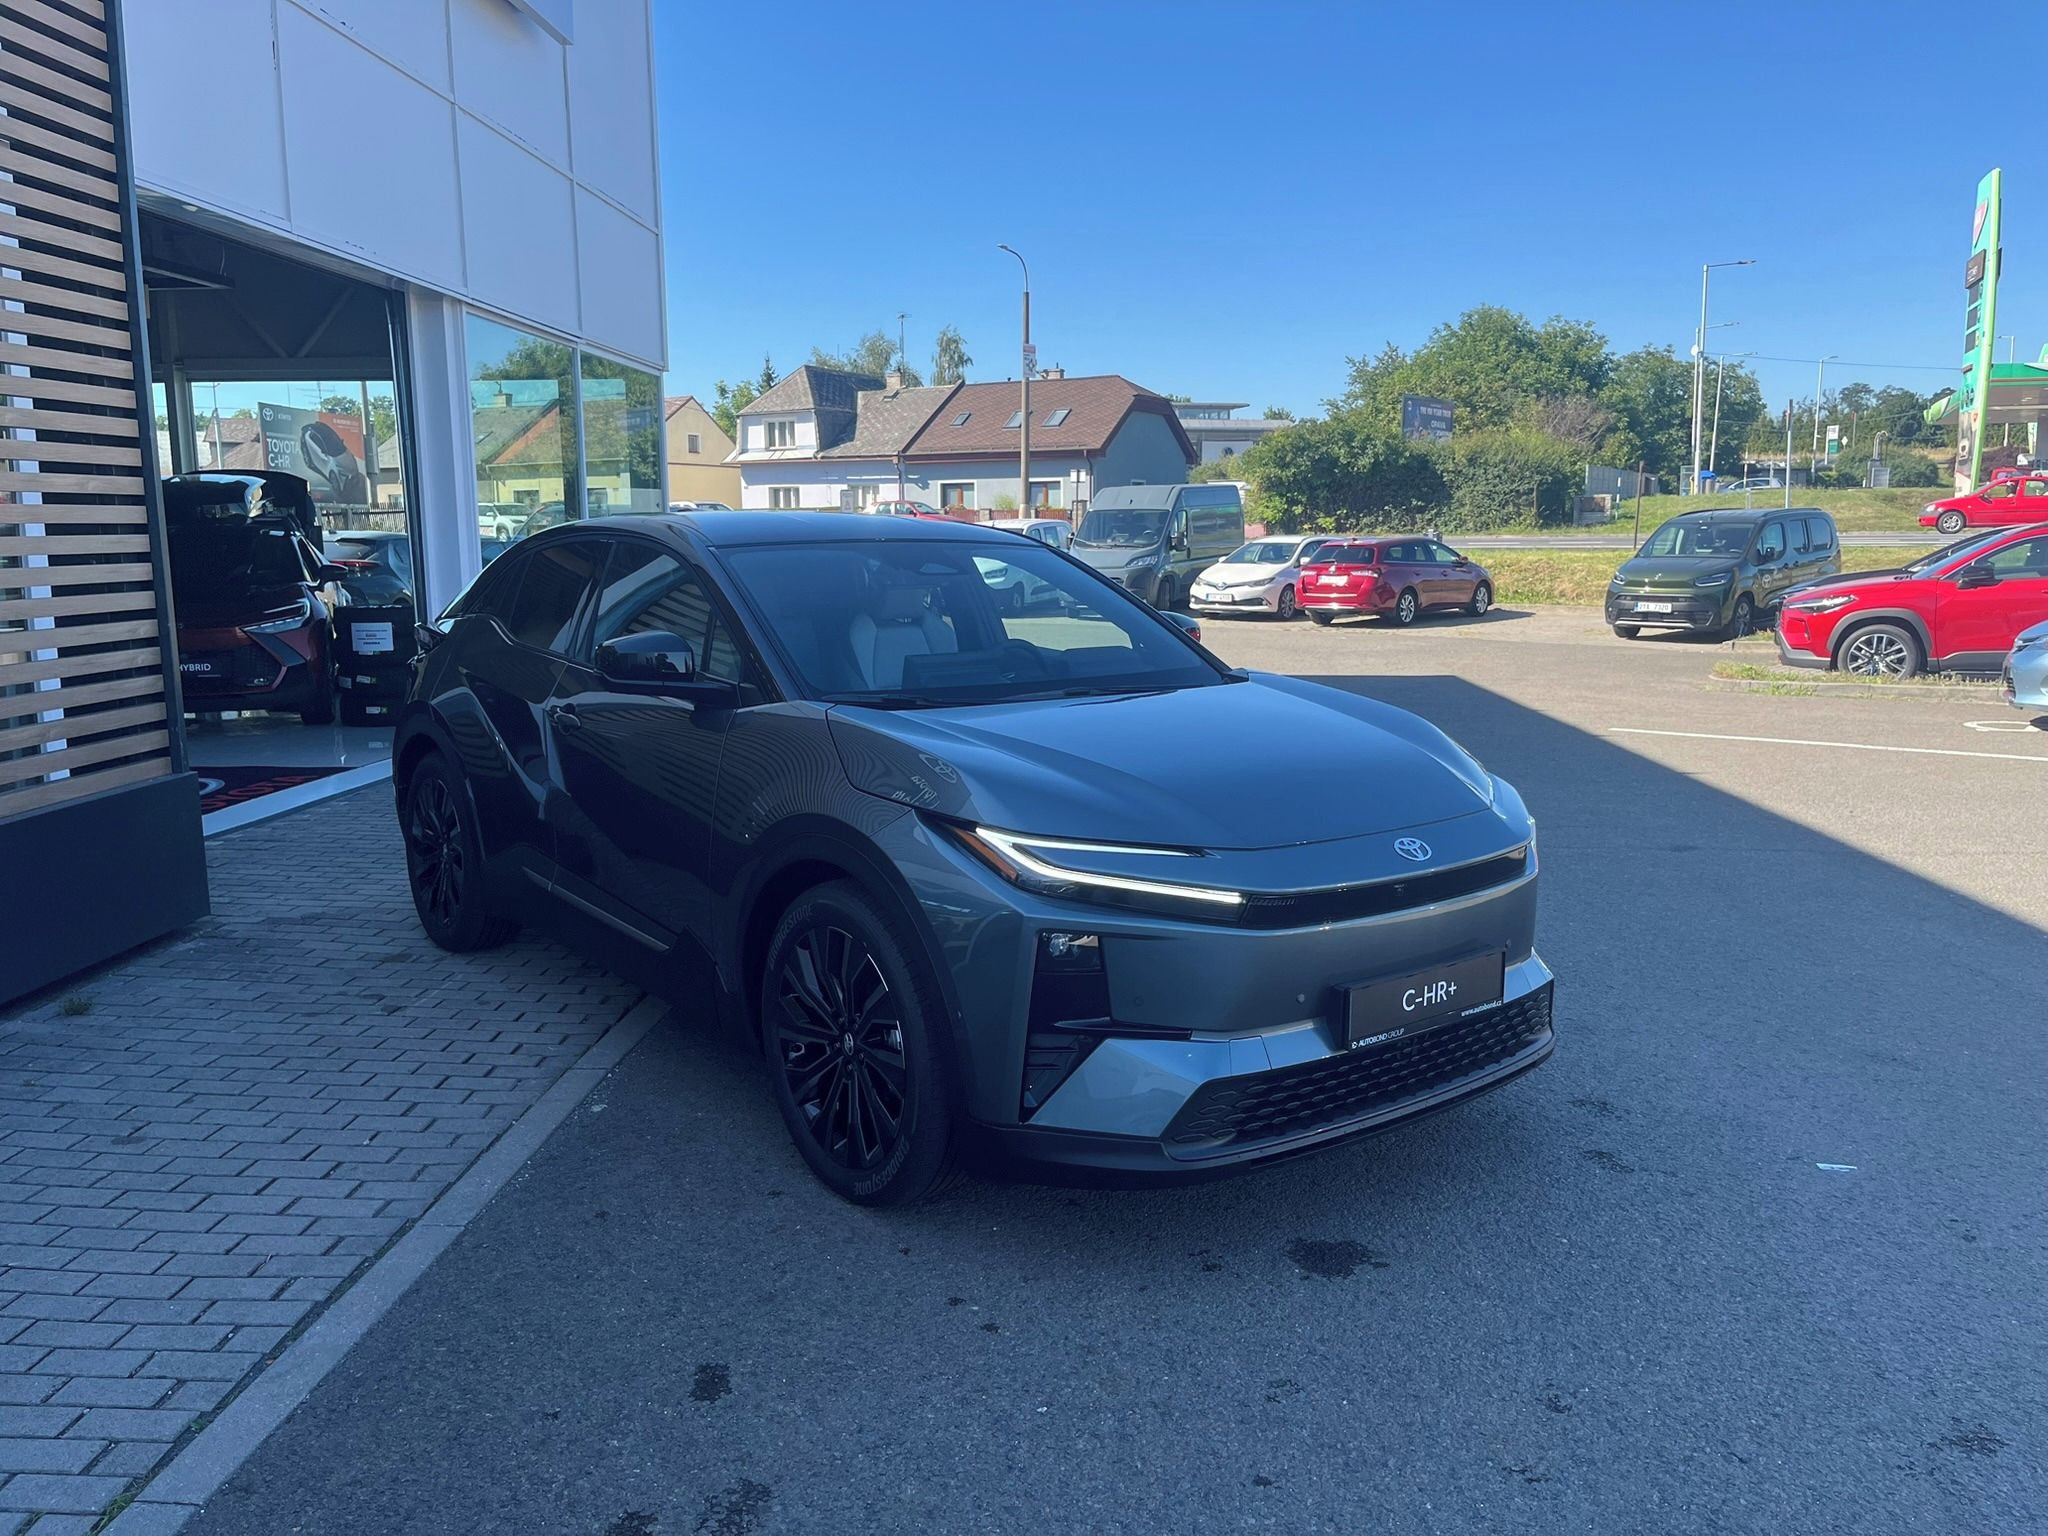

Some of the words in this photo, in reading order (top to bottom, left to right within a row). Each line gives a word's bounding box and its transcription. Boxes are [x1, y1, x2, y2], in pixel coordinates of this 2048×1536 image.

[266, 438, 301, 456] TOYOTA
[268, 454, 292, 469] C-HR
[1402, 980, 1457, 1011] C-HR+
[1461, 1000, 1502, 1017] www.autobond.cz
[1358, 1031, 1388, 1048] AUTOBOND
[1387, 1027, 1405, 1040] GROUP
